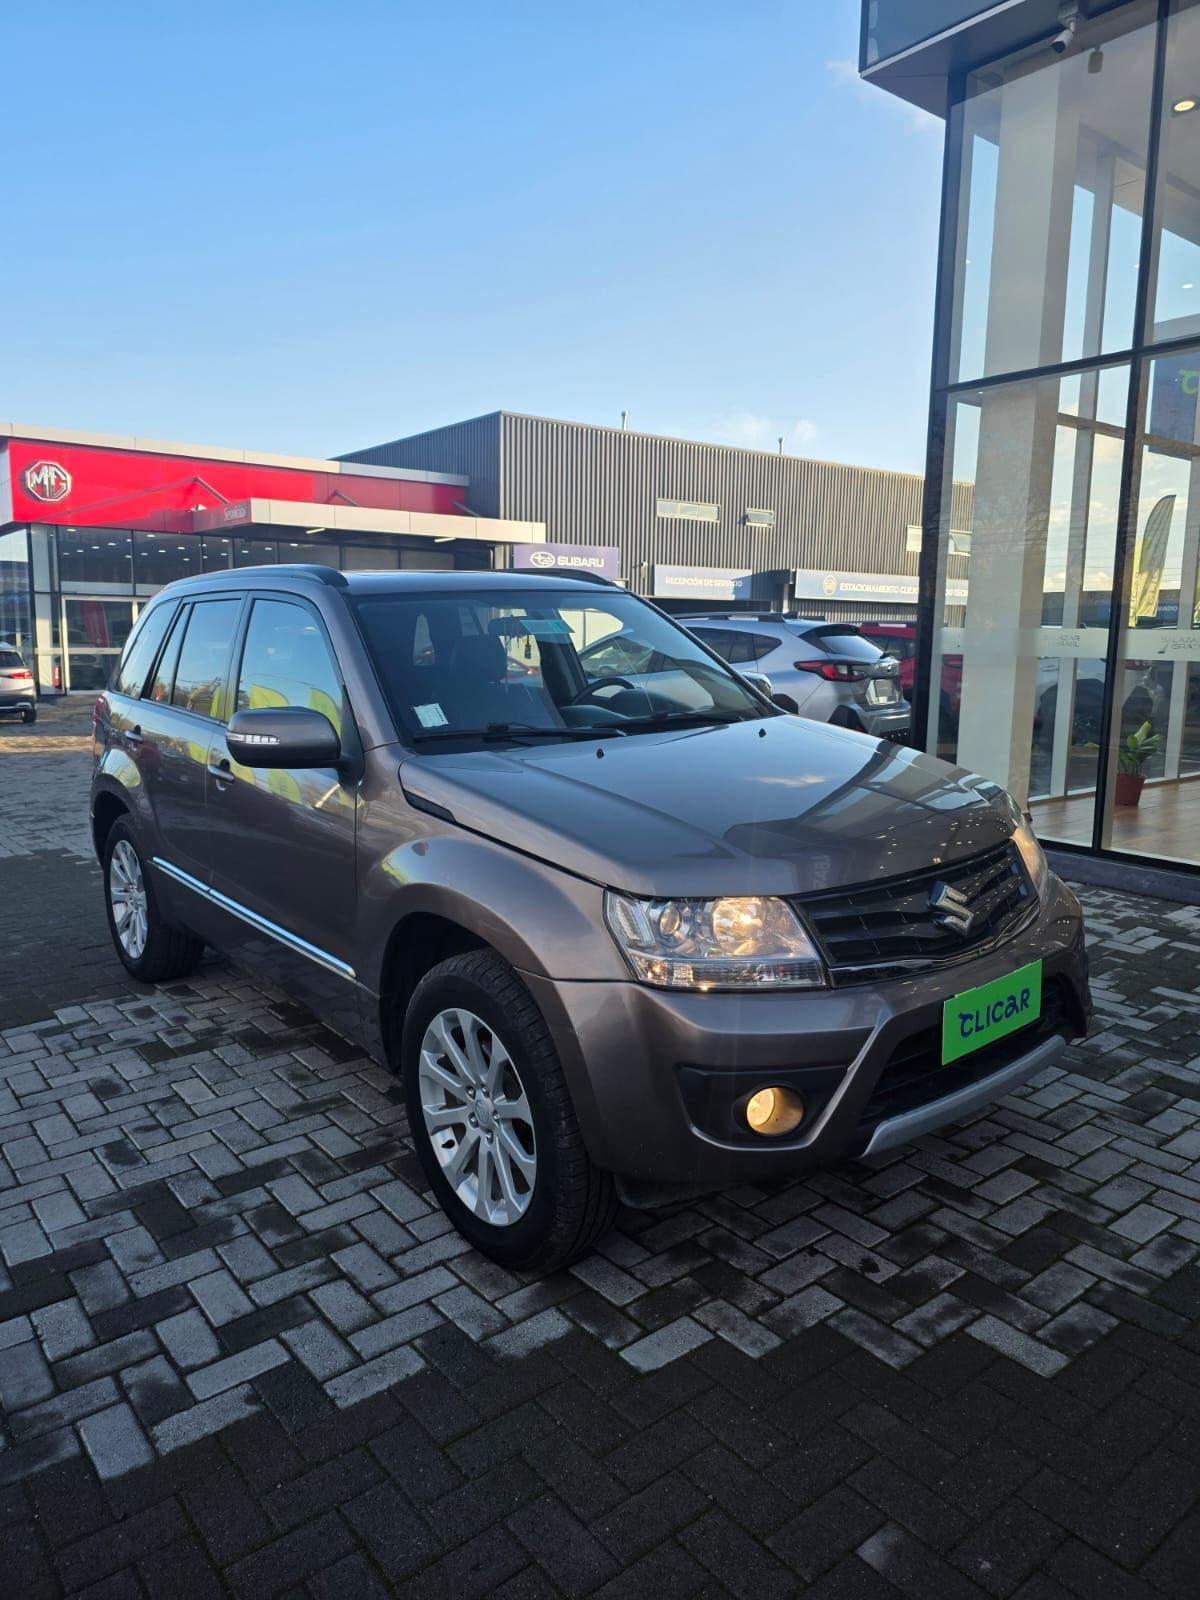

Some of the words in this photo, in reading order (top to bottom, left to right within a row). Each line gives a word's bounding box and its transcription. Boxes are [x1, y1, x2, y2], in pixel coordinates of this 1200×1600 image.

[29, 463, 69, 499] MG
[557, 555, 604, 568] SUBARU
[839, 582, 899, 594] ESTACIONAMIENTO
